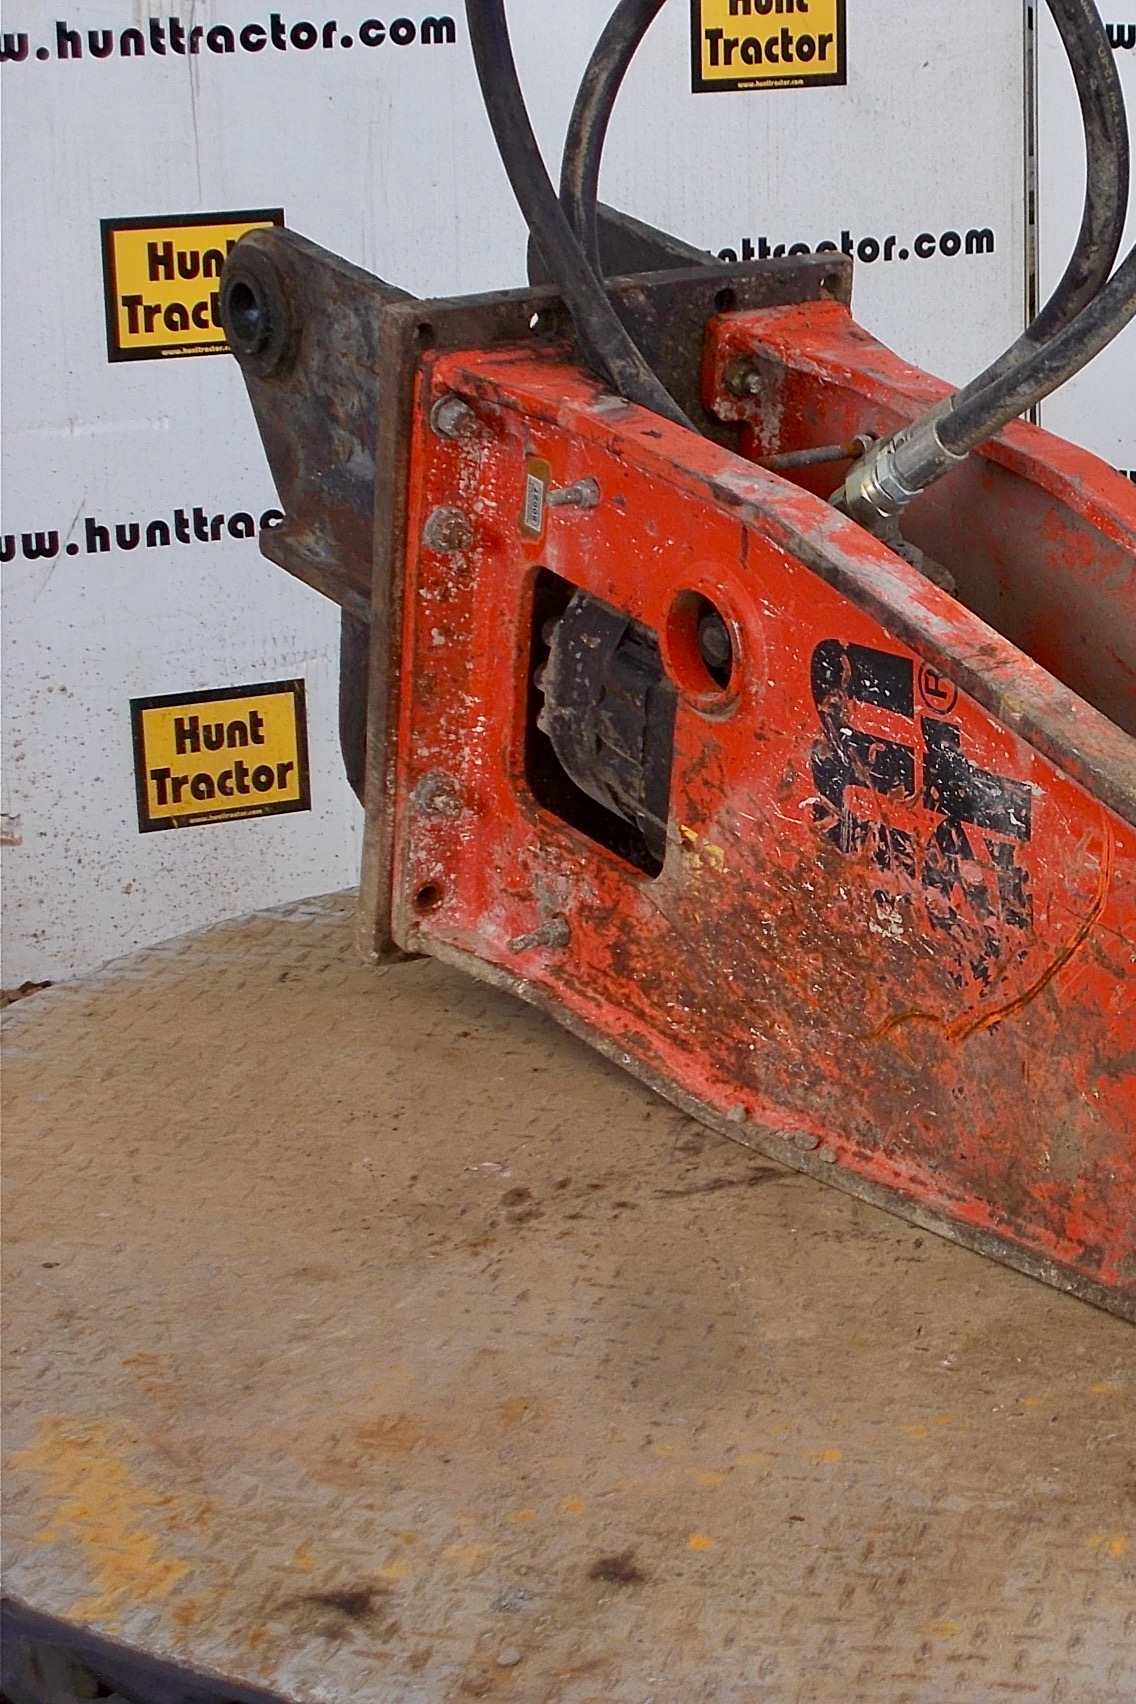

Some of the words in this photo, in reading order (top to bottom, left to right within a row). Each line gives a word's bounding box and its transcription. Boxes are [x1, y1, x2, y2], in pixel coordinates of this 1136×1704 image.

[704, 27, 833, 66] Tractor
[174, 710, 265, 755] Hunt
[150, 760, 294, 805] Tractor
